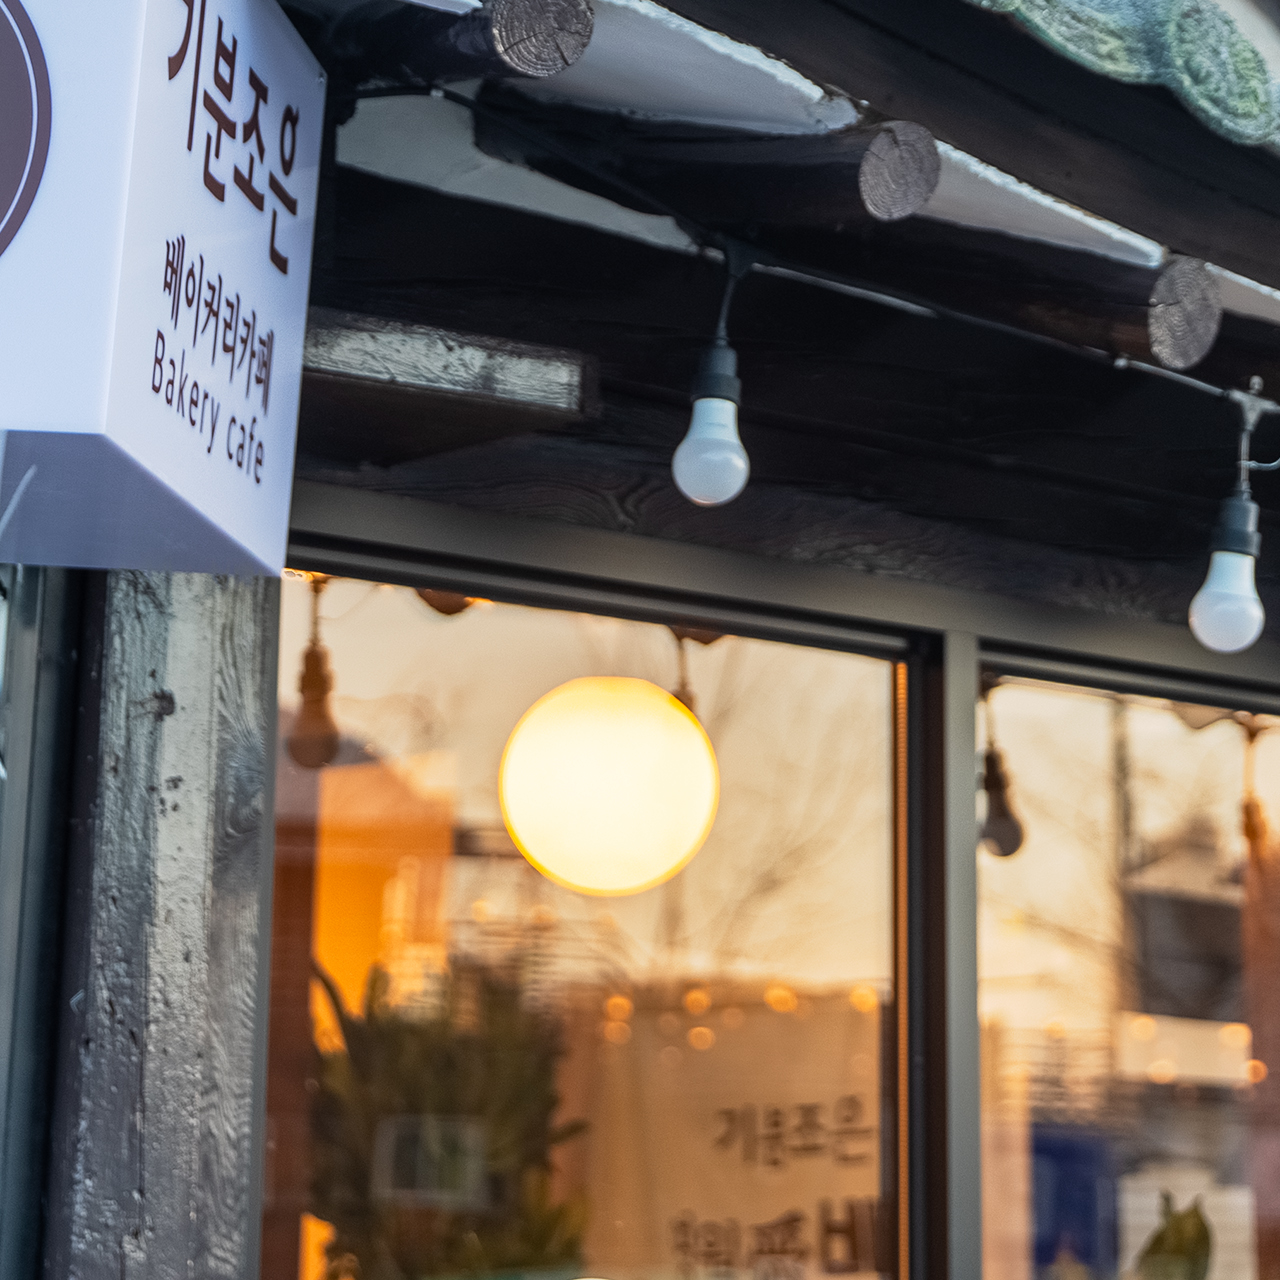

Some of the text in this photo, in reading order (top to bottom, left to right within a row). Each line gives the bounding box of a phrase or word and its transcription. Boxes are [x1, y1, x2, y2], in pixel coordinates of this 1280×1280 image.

[151, 328, 265, 485] Bakery cafe
[163, 233, 274, 416] 베이커리카페
